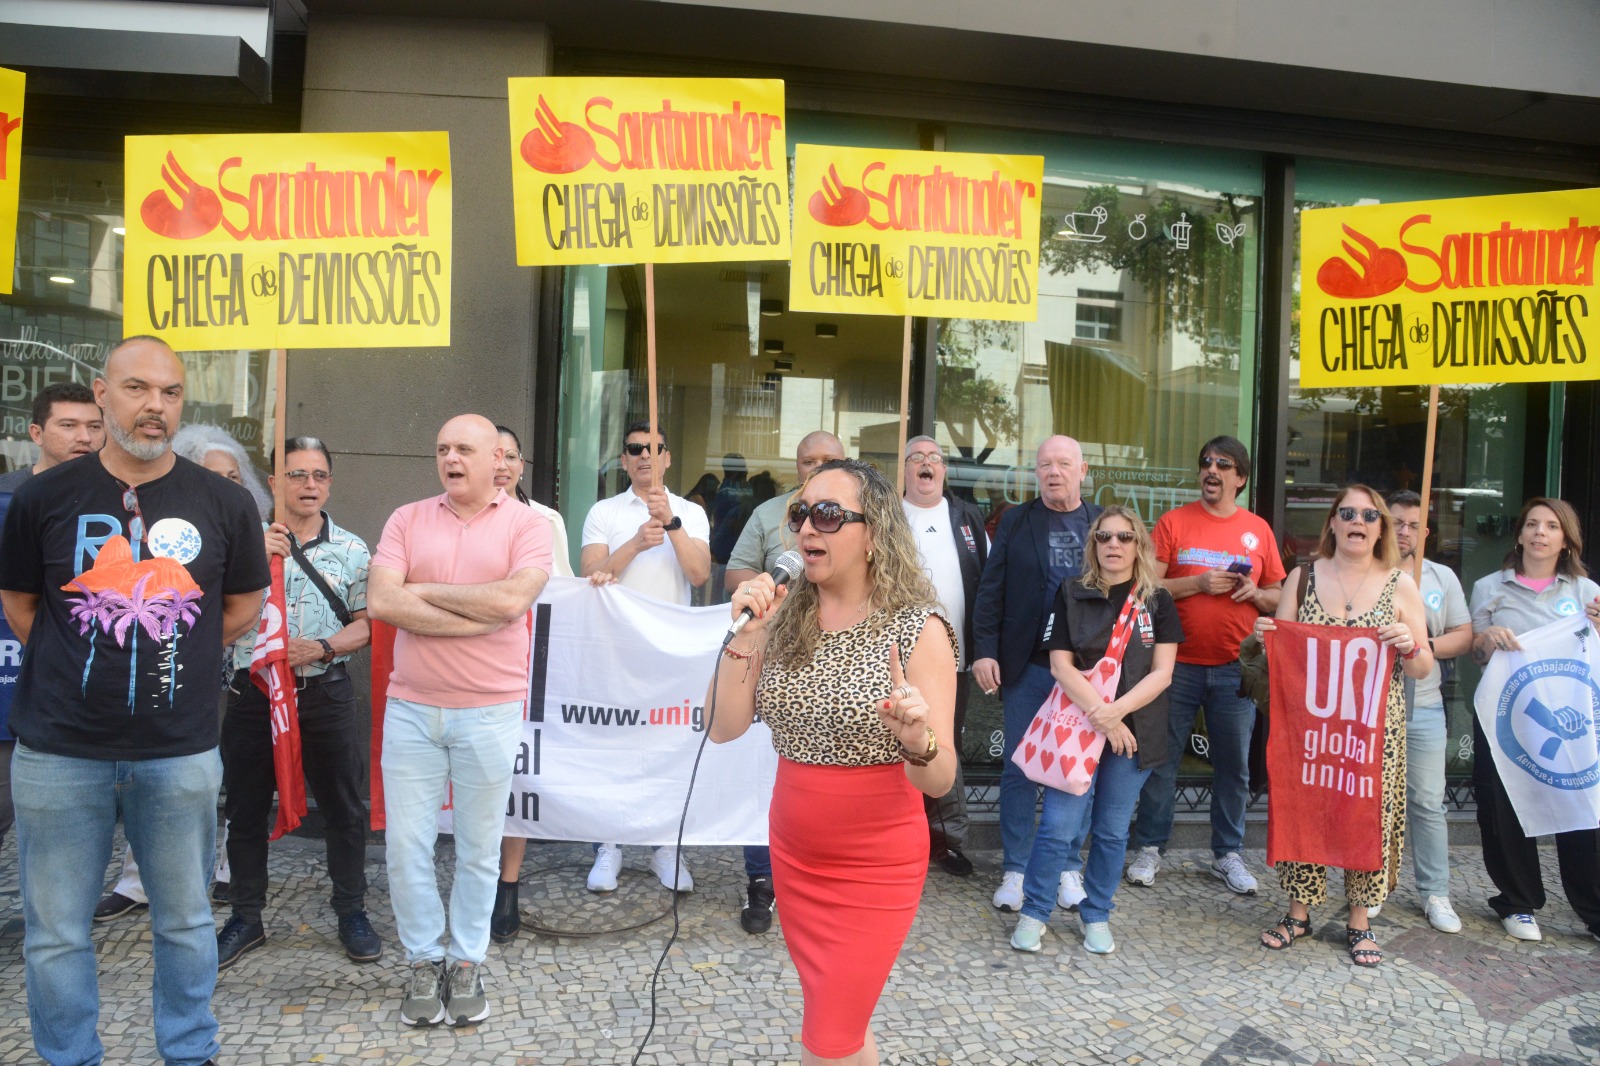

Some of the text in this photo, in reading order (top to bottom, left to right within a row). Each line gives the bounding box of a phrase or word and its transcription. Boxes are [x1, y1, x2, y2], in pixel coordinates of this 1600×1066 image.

[585, 96, 783, 173] Santander
[218, 156, 443, 241] Santander
[542, 175, 781, 251] CHEGA de DEMISSÕES
[862, 161, 1036, 240] Santander
[809, 241, 1032, 305] CHEGA de DEMISSÕES
[1400, 214, 1600, 293] Santander
[147, 242, 441, 330] CHEGA de DEMISSÕES
[3, 325, 112, 361] velkomme
[1320, 289, 1589, 372] CHEGA de DEMISSÕES
[1108, 469, 1171, 483] conversar
[1049, 548, 1082, 568] IESE
[1305, 637, 1388, 728] UNI
[1498, 678, 1520, 717] Sindicato
[1518, 671, 1529, 682] de
[1527, 661, 1586, 676] Trabajadores
[561, 699, 705, 732] www.unig
[1304, 723, 1376, 764] global
[1302, 757, 1373, 798] union
[1516, 753, 1553, 784] Paraguay
[1561, 766, 1600, 788] rgentina
